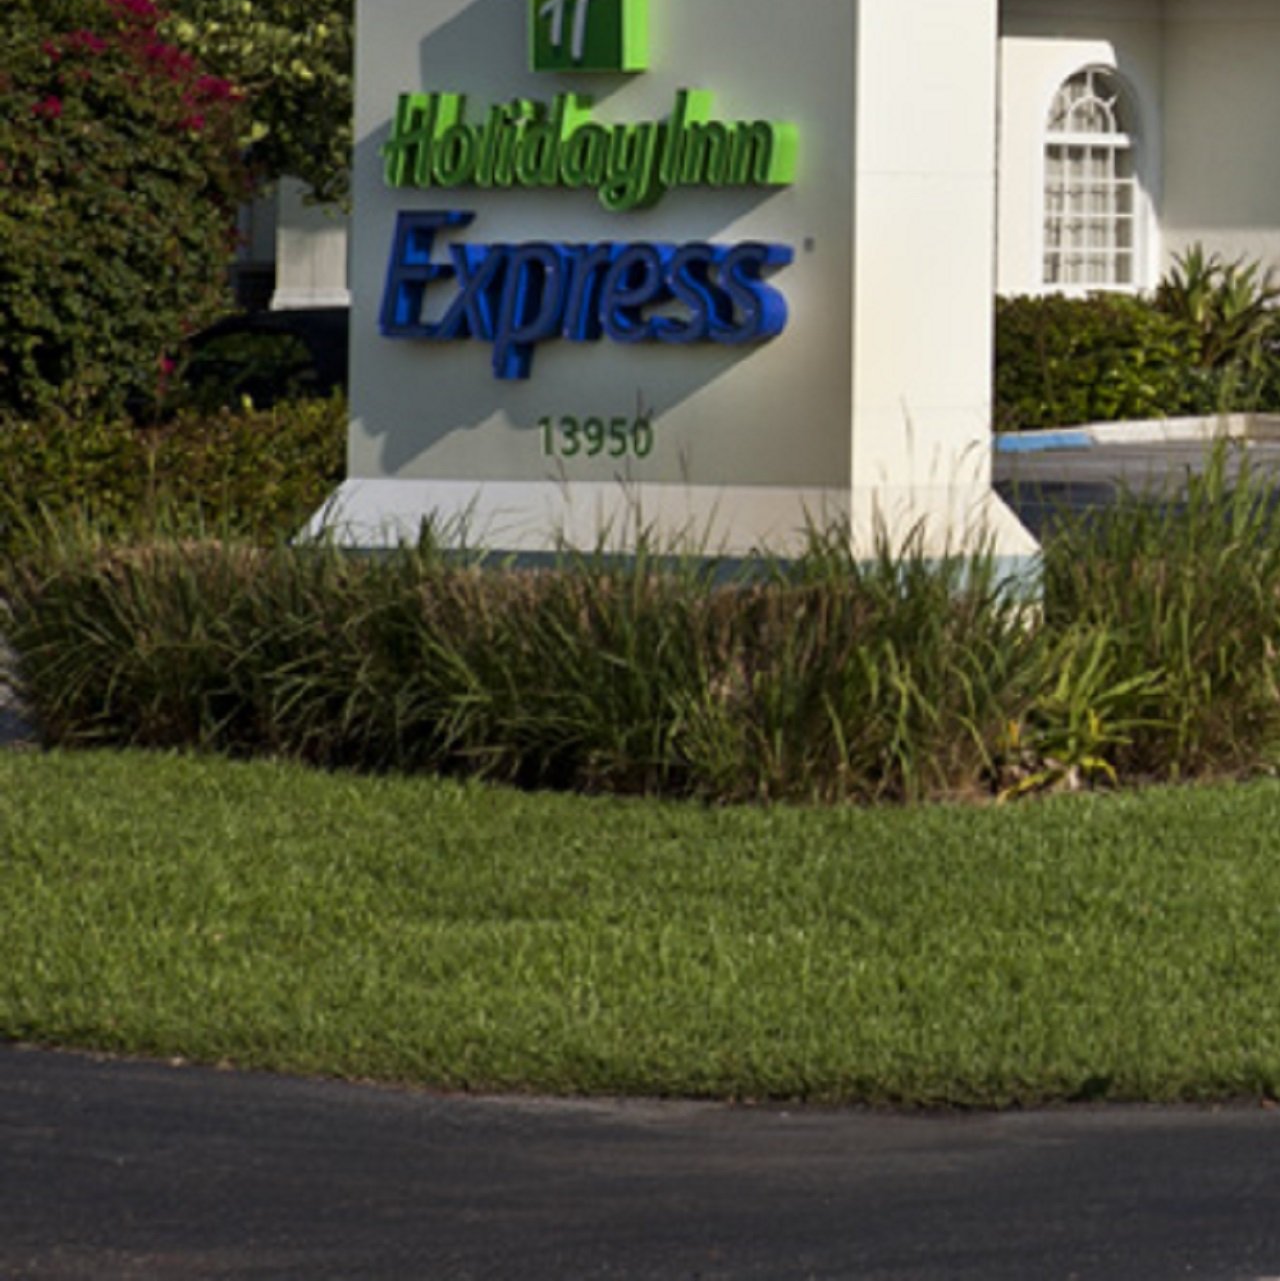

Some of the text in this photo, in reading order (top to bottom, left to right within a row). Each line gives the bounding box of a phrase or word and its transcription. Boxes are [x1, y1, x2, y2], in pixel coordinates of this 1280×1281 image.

[381, 88, 798, 211] Holiday Inn
[379, 210, 795, 380] Express
[537, 416, 654, 459] 13950
